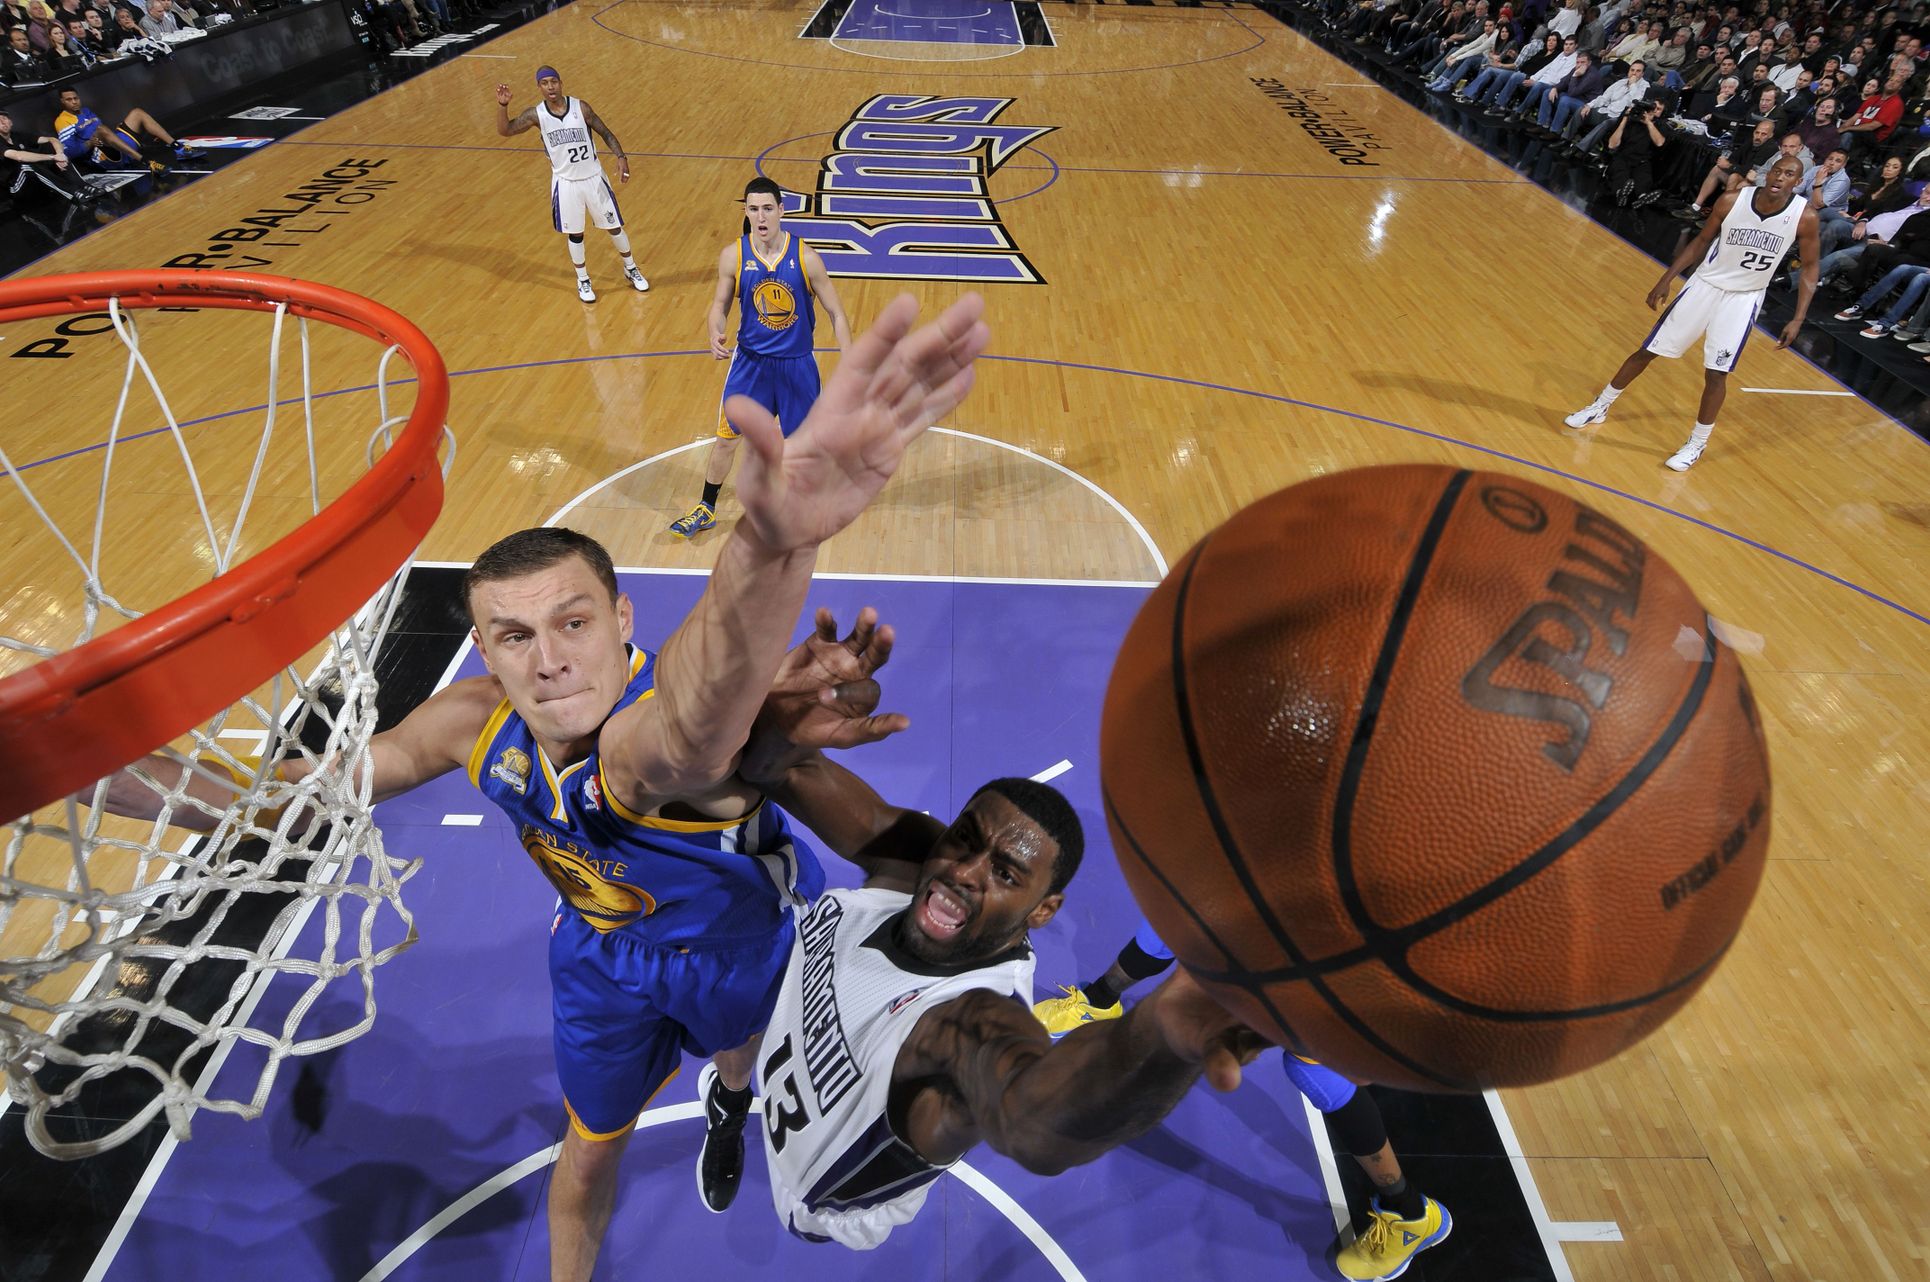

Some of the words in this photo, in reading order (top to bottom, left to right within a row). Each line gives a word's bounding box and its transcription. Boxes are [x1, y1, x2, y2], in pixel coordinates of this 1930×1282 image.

[1296, 88, 1393, 149] PAVILION
[568, 145, 589, 163] 22
[1726, 228, 1784, 254] SACRAMENTO
[1740, 251, 1775, 271] 25
[772, 289, 781, 300] 11
[757, 313, 799, 331] WARRIORS
[566, 842, 629, 877] STATE
[799, 895, 864, 1118] SACRAMENTO
[763, 1032, 811, 1155] 13
